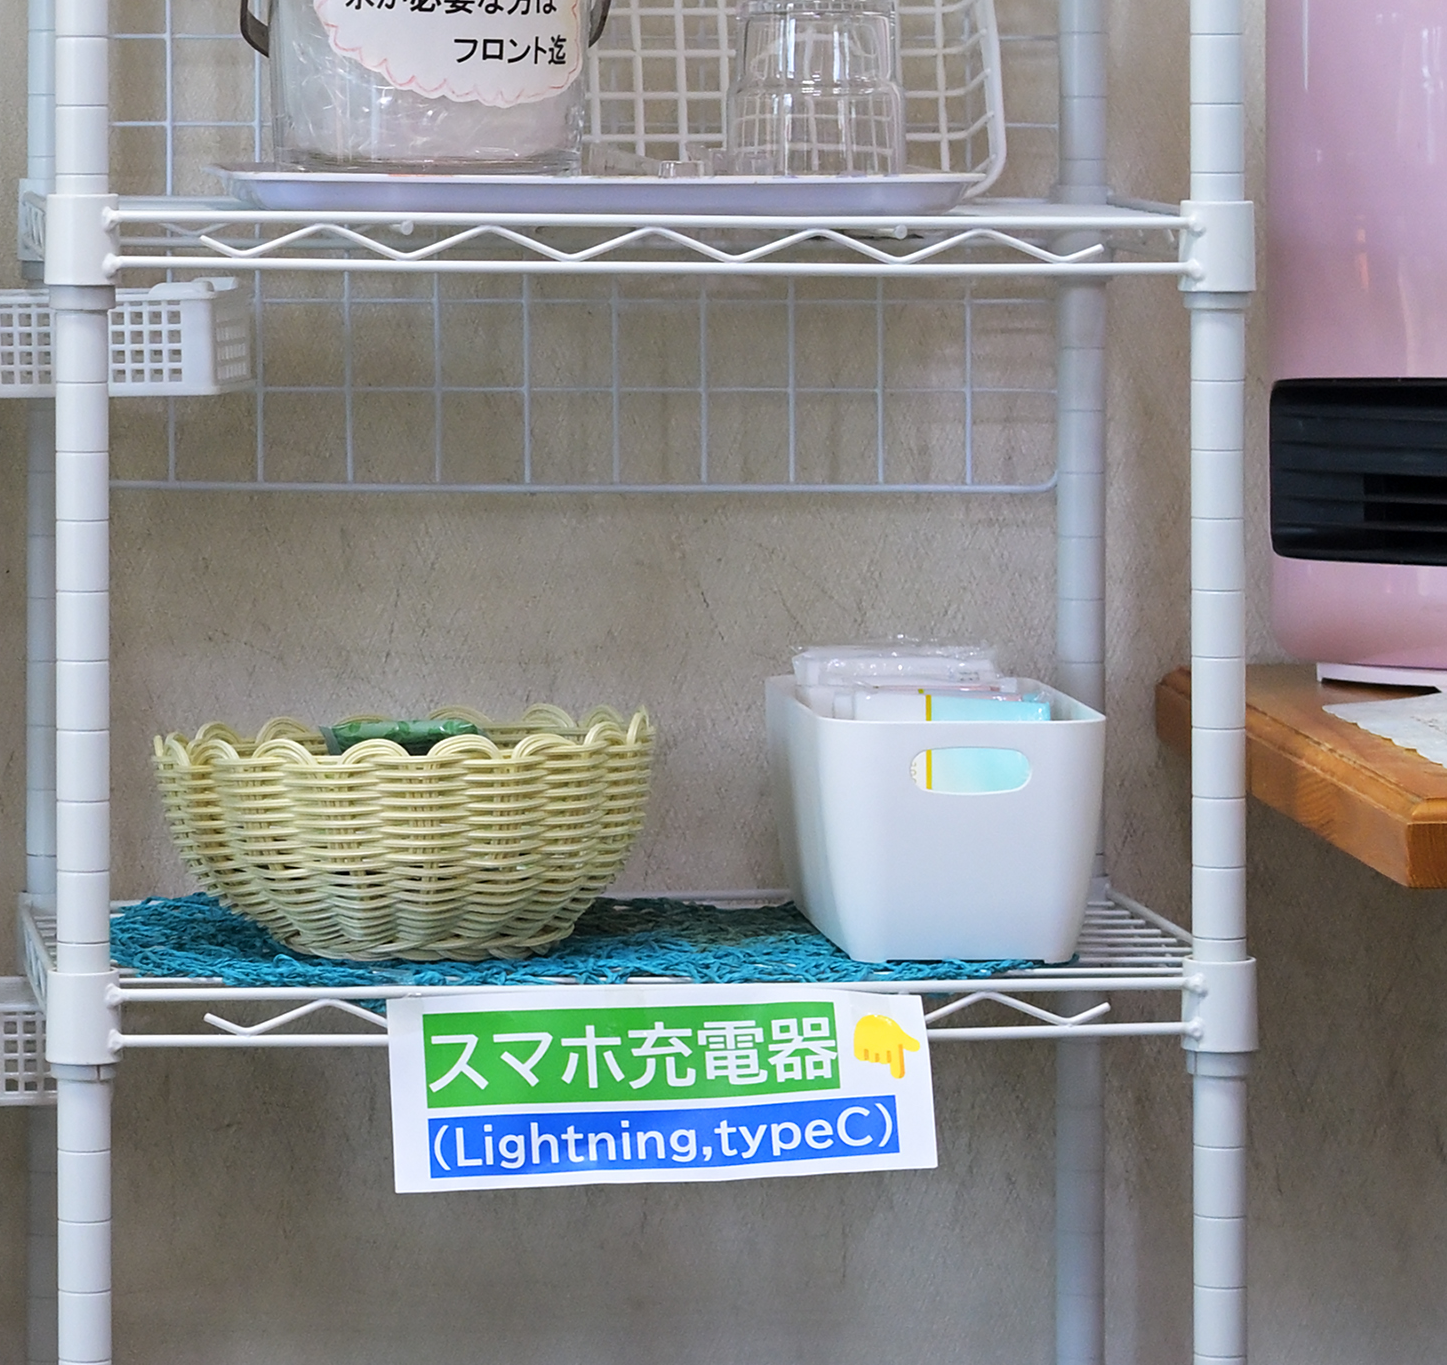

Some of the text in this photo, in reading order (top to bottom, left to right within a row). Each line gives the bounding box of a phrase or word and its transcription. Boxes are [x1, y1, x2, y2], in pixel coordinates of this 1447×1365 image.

[452, 34, 569, 68] フロント迄
[427, 1016, 839, 1094] スマホ充電器
[432, 1103, 895, 1173] (Lightning,typeC)
